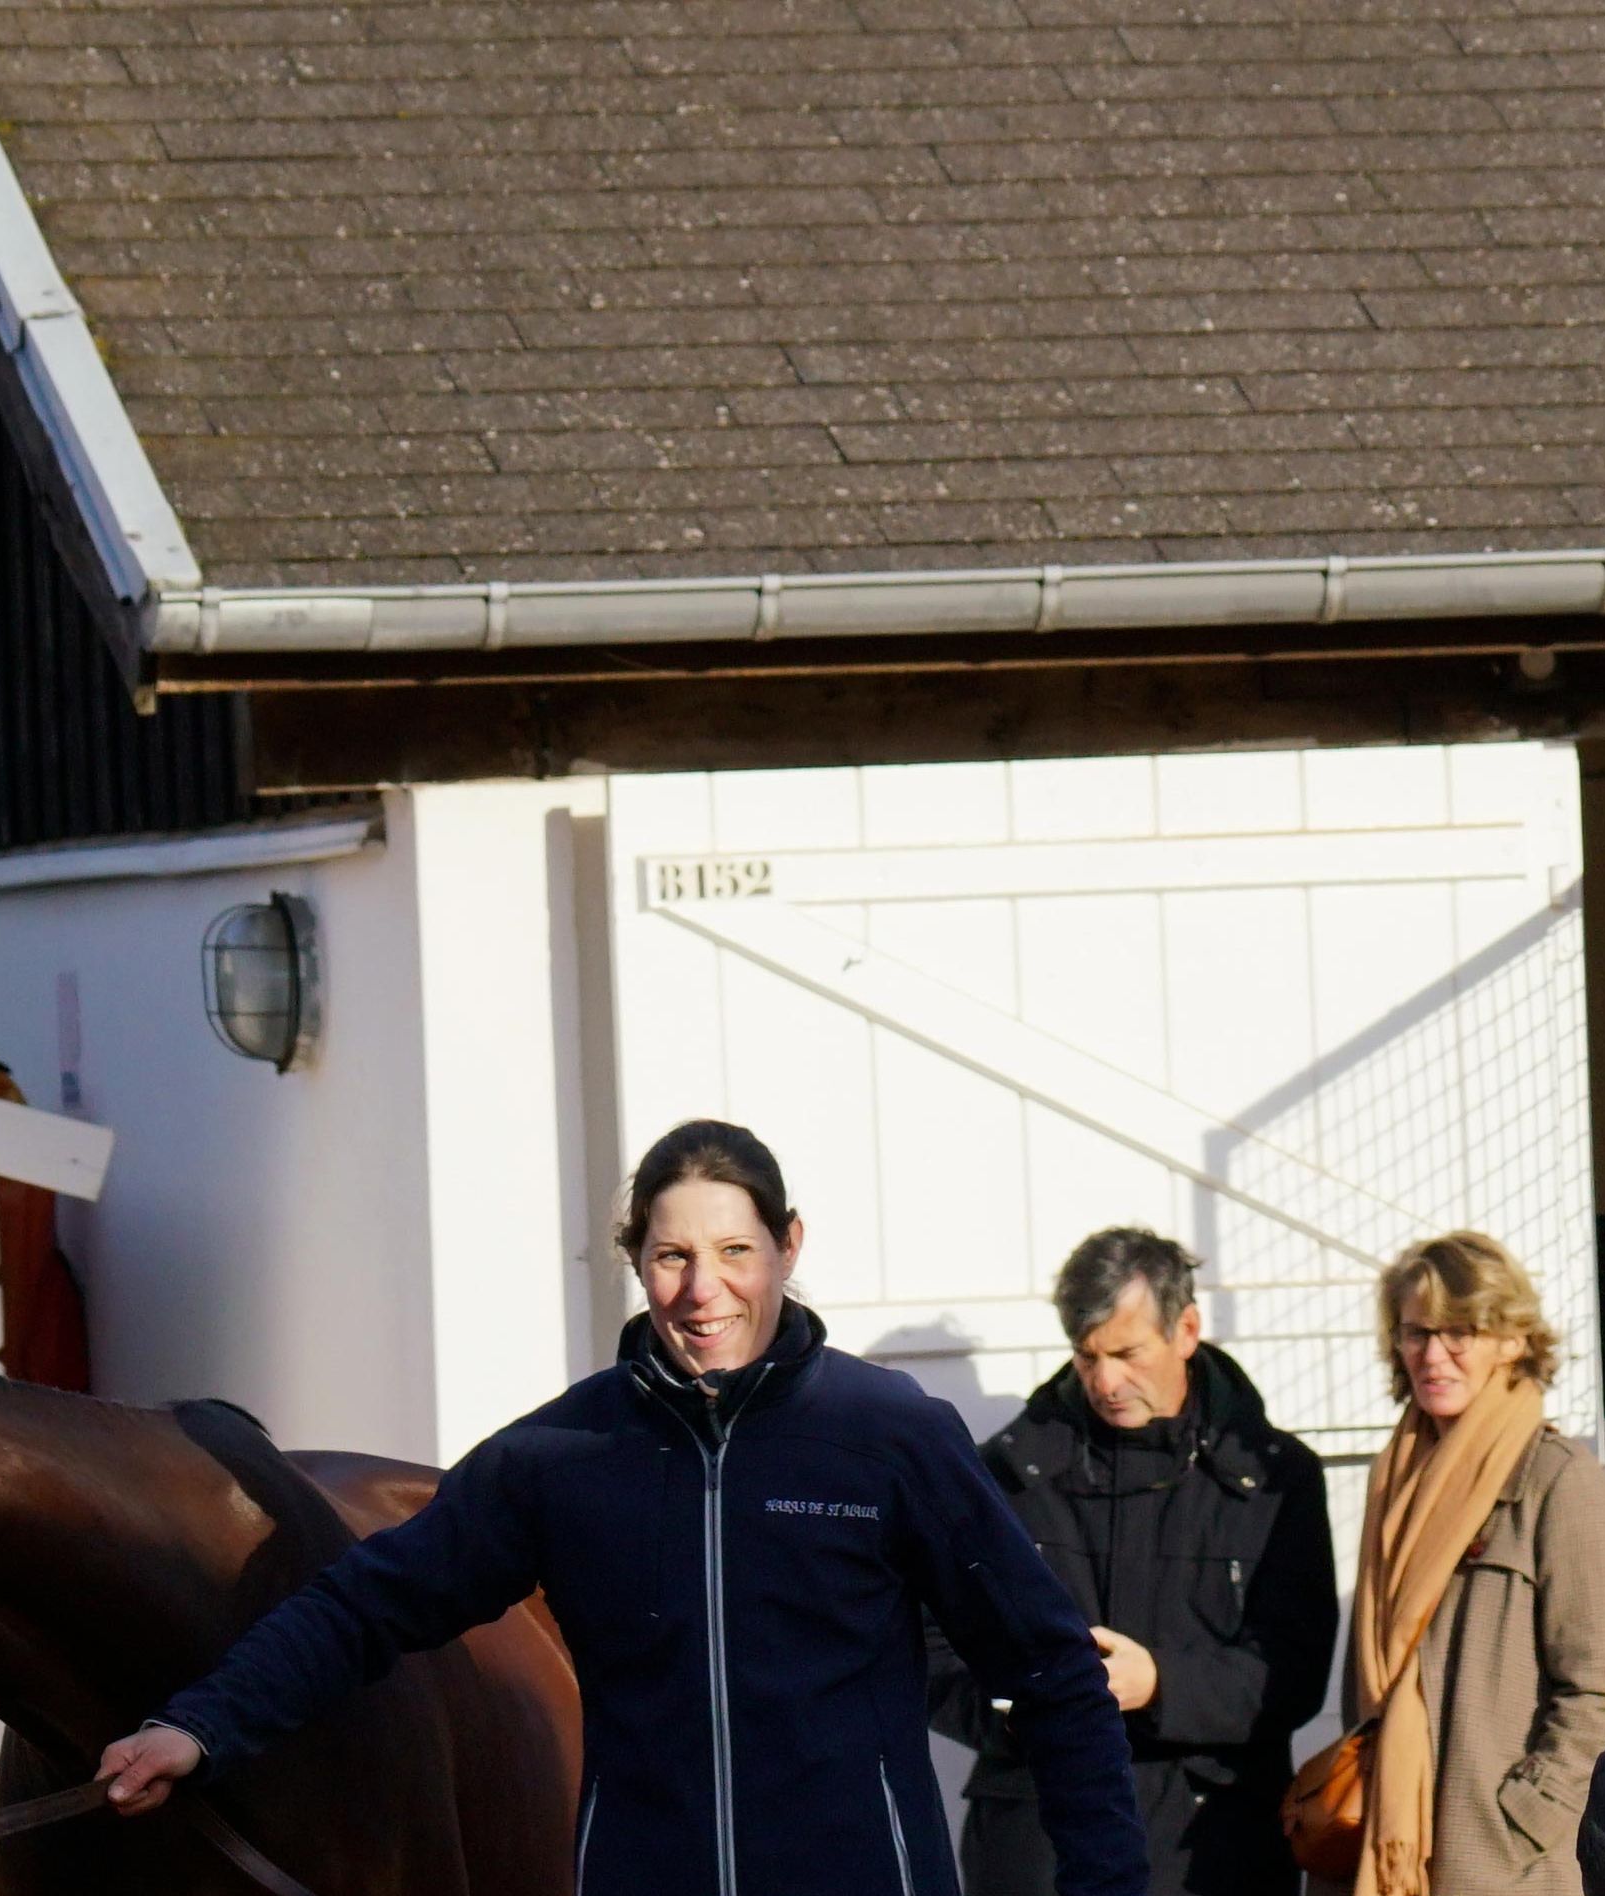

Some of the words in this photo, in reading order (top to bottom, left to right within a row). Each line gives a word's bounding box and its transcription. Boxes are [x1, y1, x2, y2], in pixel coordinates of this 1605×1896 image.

[764, 1498, 806, 1515] HARAS
[807, 1501, 825, 1515] DE
[826, 1502, 843, 1516] ST
[842, 1503, 880, 1521] MAUR
